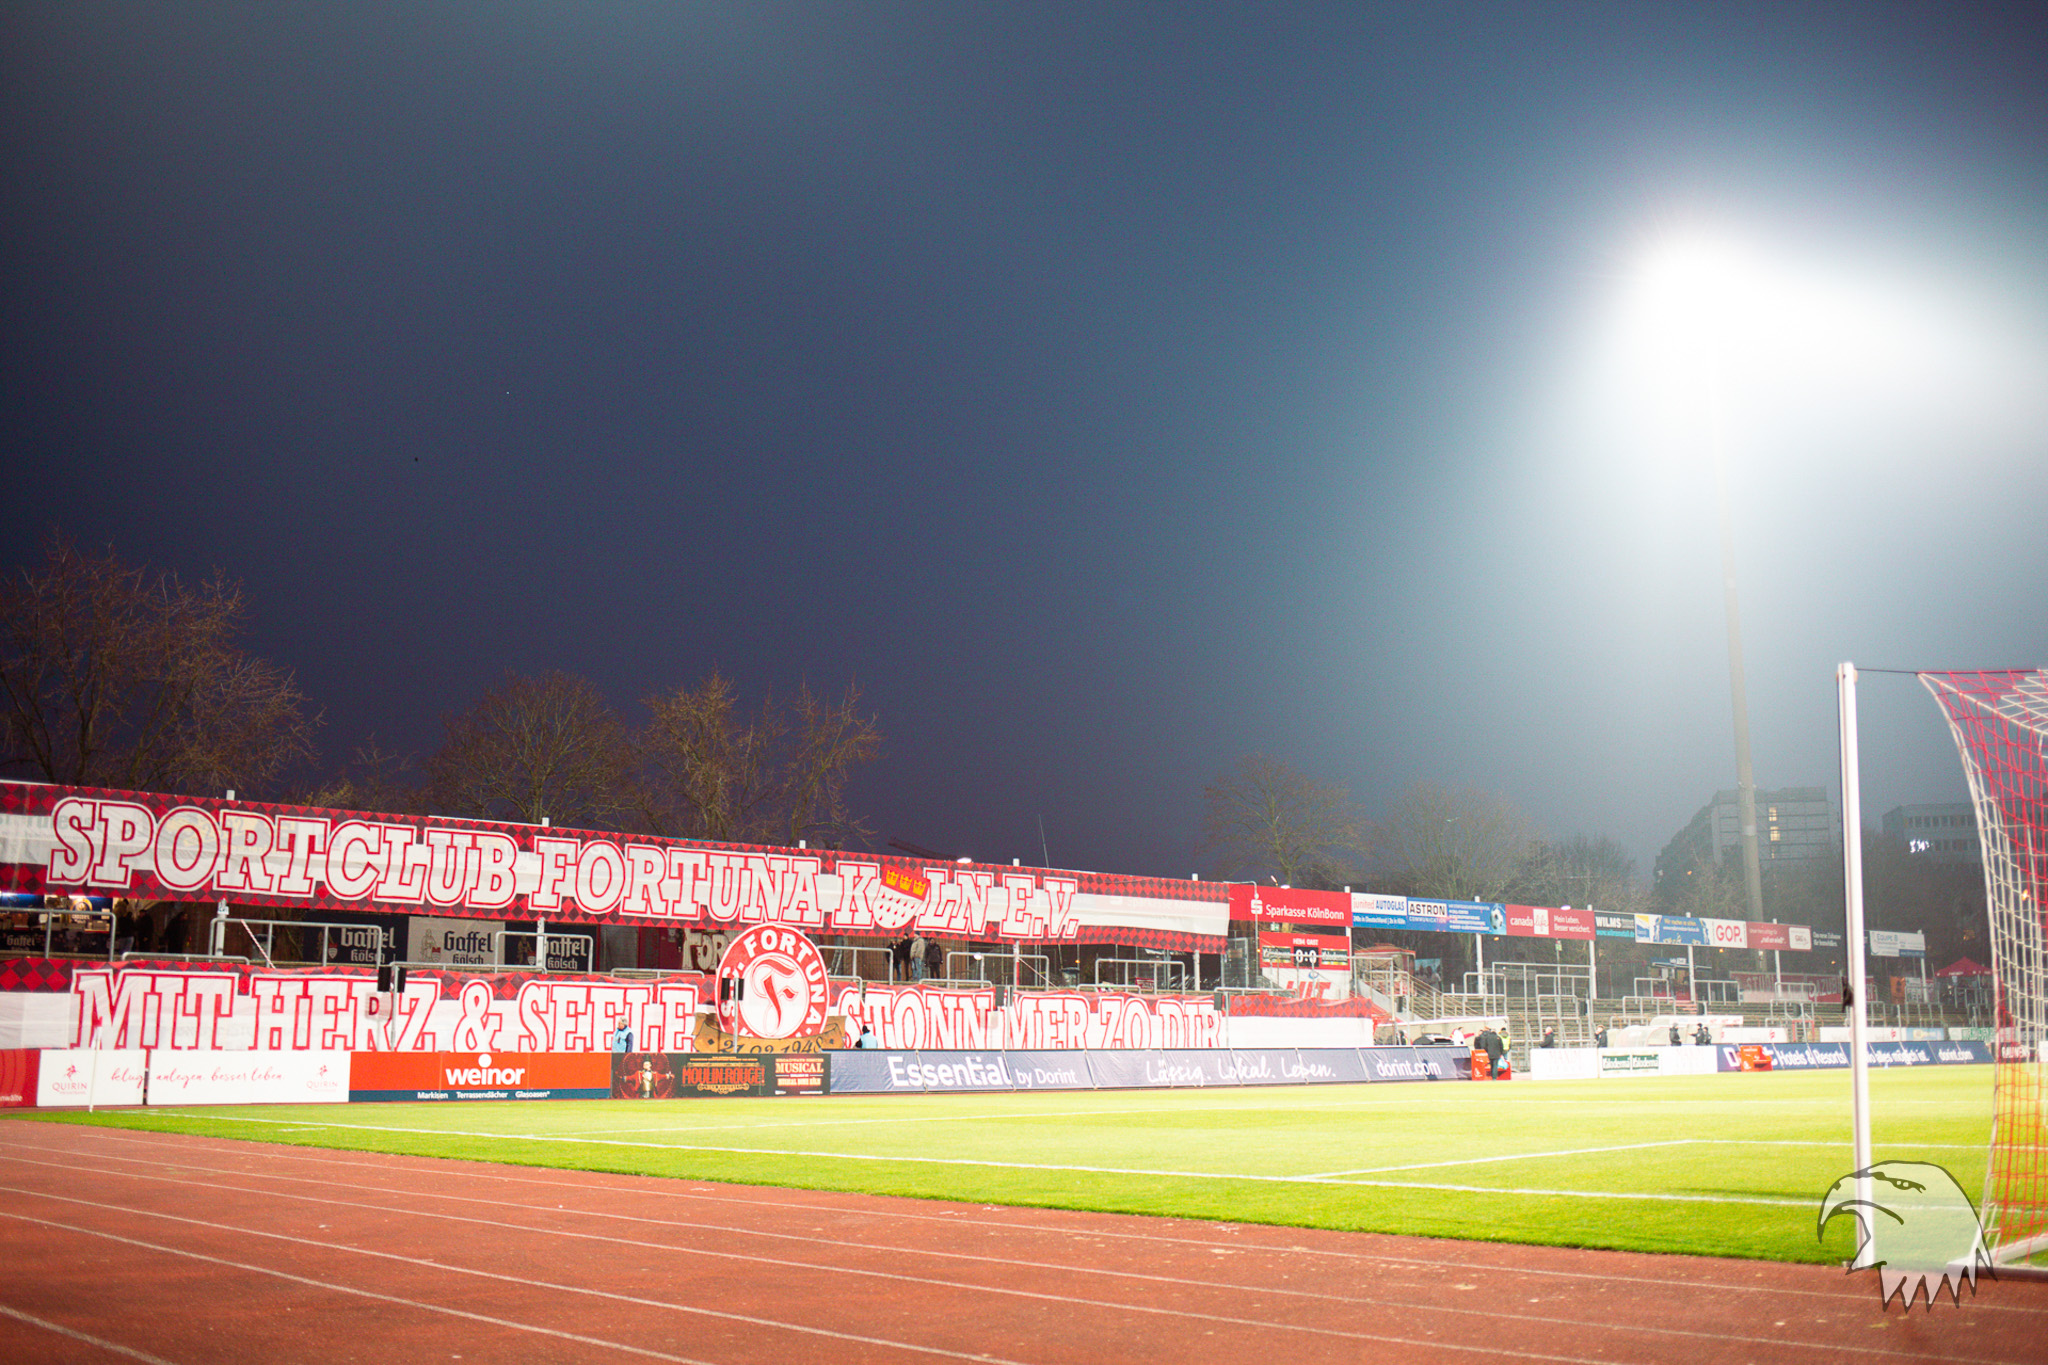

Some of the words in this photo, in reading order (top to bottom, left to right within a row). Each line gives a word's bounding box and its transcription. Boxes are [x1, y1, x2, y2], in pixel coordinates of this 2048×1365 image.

[47, 797, 519, 910] SPORTCLUB
[529, 834, 824, 928] FORTUNA
[999, 873, 1079, 939] E.V.
[1265, 903, 1306, 918] Sparkasse
[1306, 907, 1345, 920] KölnBonn
[1375, 900, 1405, 911] AUTOGLAS
[1409, 903, 1445, 915] ASTRON
[1509, 915, 1533, 927] canada
[1595, 916, 1622, 929] WILMS
[340, 925, 397, 950] Gaffel
[443, 930, 494, 953] Gaffel
[1715, 924, 1743, 943] GOP.
[547, 956, 579, 970] Kölsch
[743, 929, 825, 1025] FORTUNA
[69, 968, 239, 1051] MIT
[248, 975, 441, 1052] HERZ
[453, 979, 503, 1052] &
[519, 979, 699, 1052] SEELE
[838, 987, 996, 1049] STONN
[1000, 991, 1091, 1049] MER
[1099, 996, 1152, 1049] ZO
[1157, 998, 1224, 1049] DIR
[1778, 1049, 1807, 1066] Hotels
[1813, 1049, 1848, 1065] Resorts
[1938, 1048, 1975, 1062] dorint.com
[211, 1067, 247, 1082] besser
[445, 1058, 526, 1085] weinor
[682, 1065, 724, 1084] MOULIN
[724, 1066, 766, 1085] ROUGE!
[775, 1062, 825, 1074] MUSICAL
[887, 1055, 1011, 1088] Essential
[1015, 1068, 1033, 1088] by
[1035, 1066, 1078, 1085] Dorint
[1145, 1058, 1212, 1088] Lässig.
[1376, 1058, 1442, 1078] dorint.com
[51, 1081, 88, 1092] QUIRIN
[306, 1079, 339, 1090] QUIRIN
[417, 1090, 449, 1100] Markisen
[456, 1090, 509, 1100] Terrassendächer
